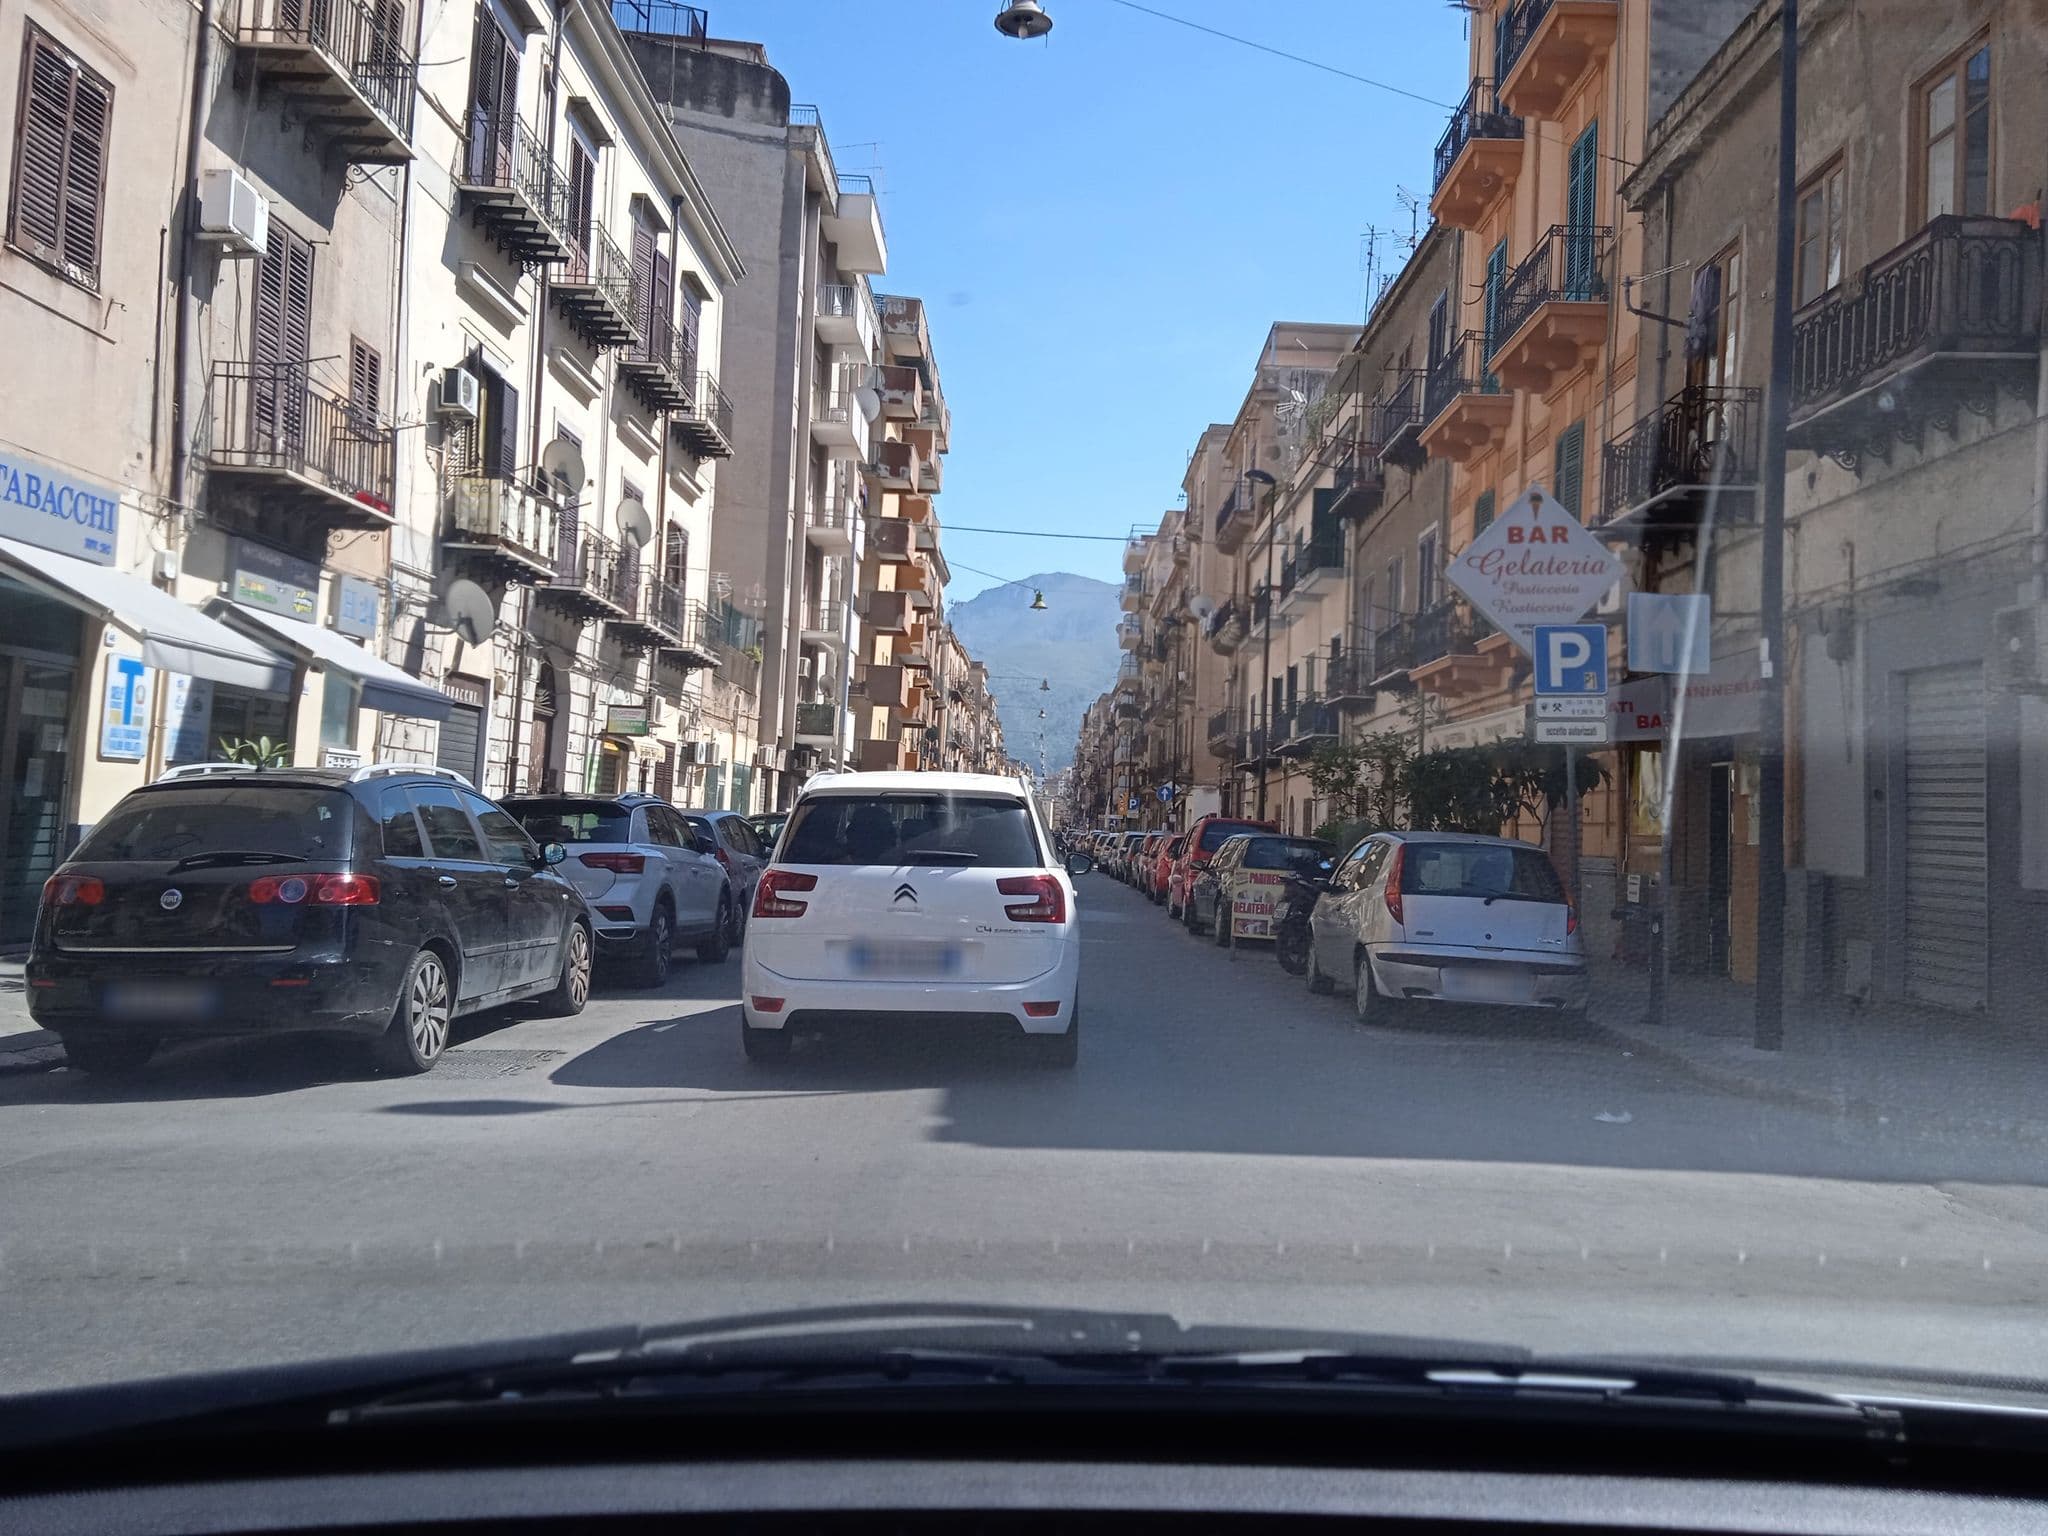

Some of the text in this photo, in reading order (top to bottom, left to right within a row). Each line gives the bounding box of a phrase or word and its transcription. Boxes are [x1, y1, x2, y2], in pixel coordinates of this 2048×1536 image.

[1507, 525, 1569, 544] BAR
[1466, 548, 1607, 585] Gelateria
[1501, 580, 1580, 597] Pasticceria
[1491, 598, 1575, 615] Rosticceria
[1548, 631, 1591, 688] P
[117, 657, 145, 725] T
[1608, 700, 1634, 713] ATI
[1636, 713, 1662, 728] BA
[1129, 799, 1137, 809] P
[163, 895, 177, 903] FIAT
